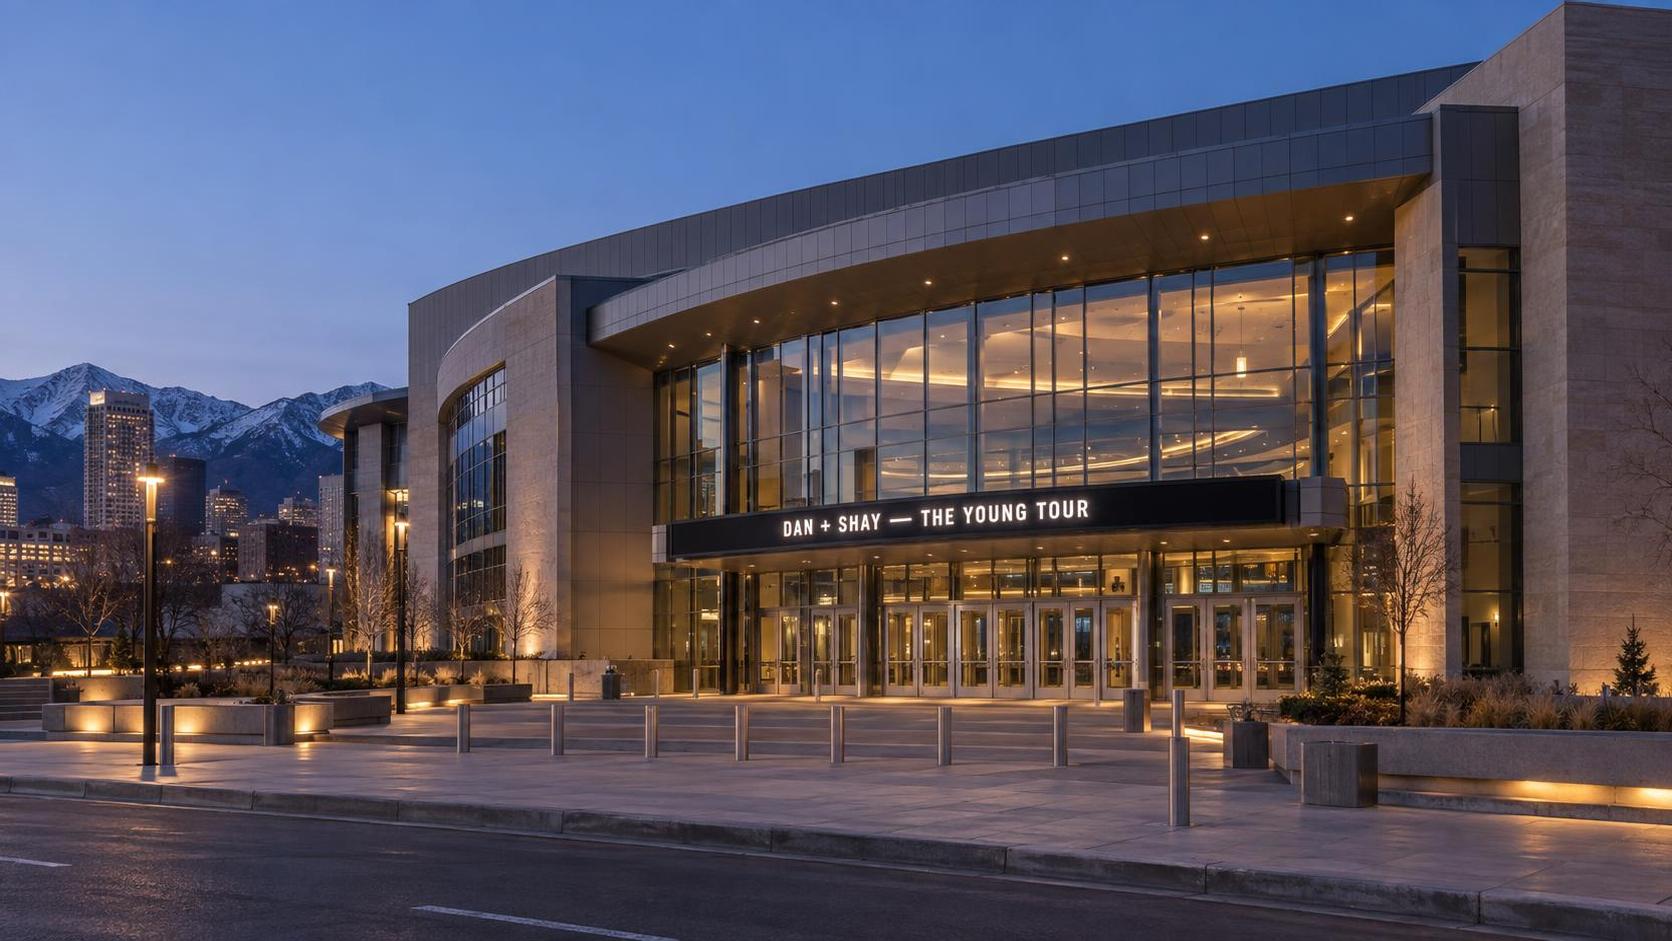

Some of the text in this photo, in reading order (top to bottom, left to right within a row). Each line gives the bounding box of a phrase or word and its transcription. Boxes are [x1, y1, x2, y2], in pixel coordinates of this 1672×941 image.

[783, 518, 813, 538] DAN
[821, 520, 831, 533] +
[838, 513, 881, 533] SHAY
[920, 507, 955, 527] THE
[963, 501, 1027, 525] YOUNG
[1036, 498, 1089, 520] TOUR
